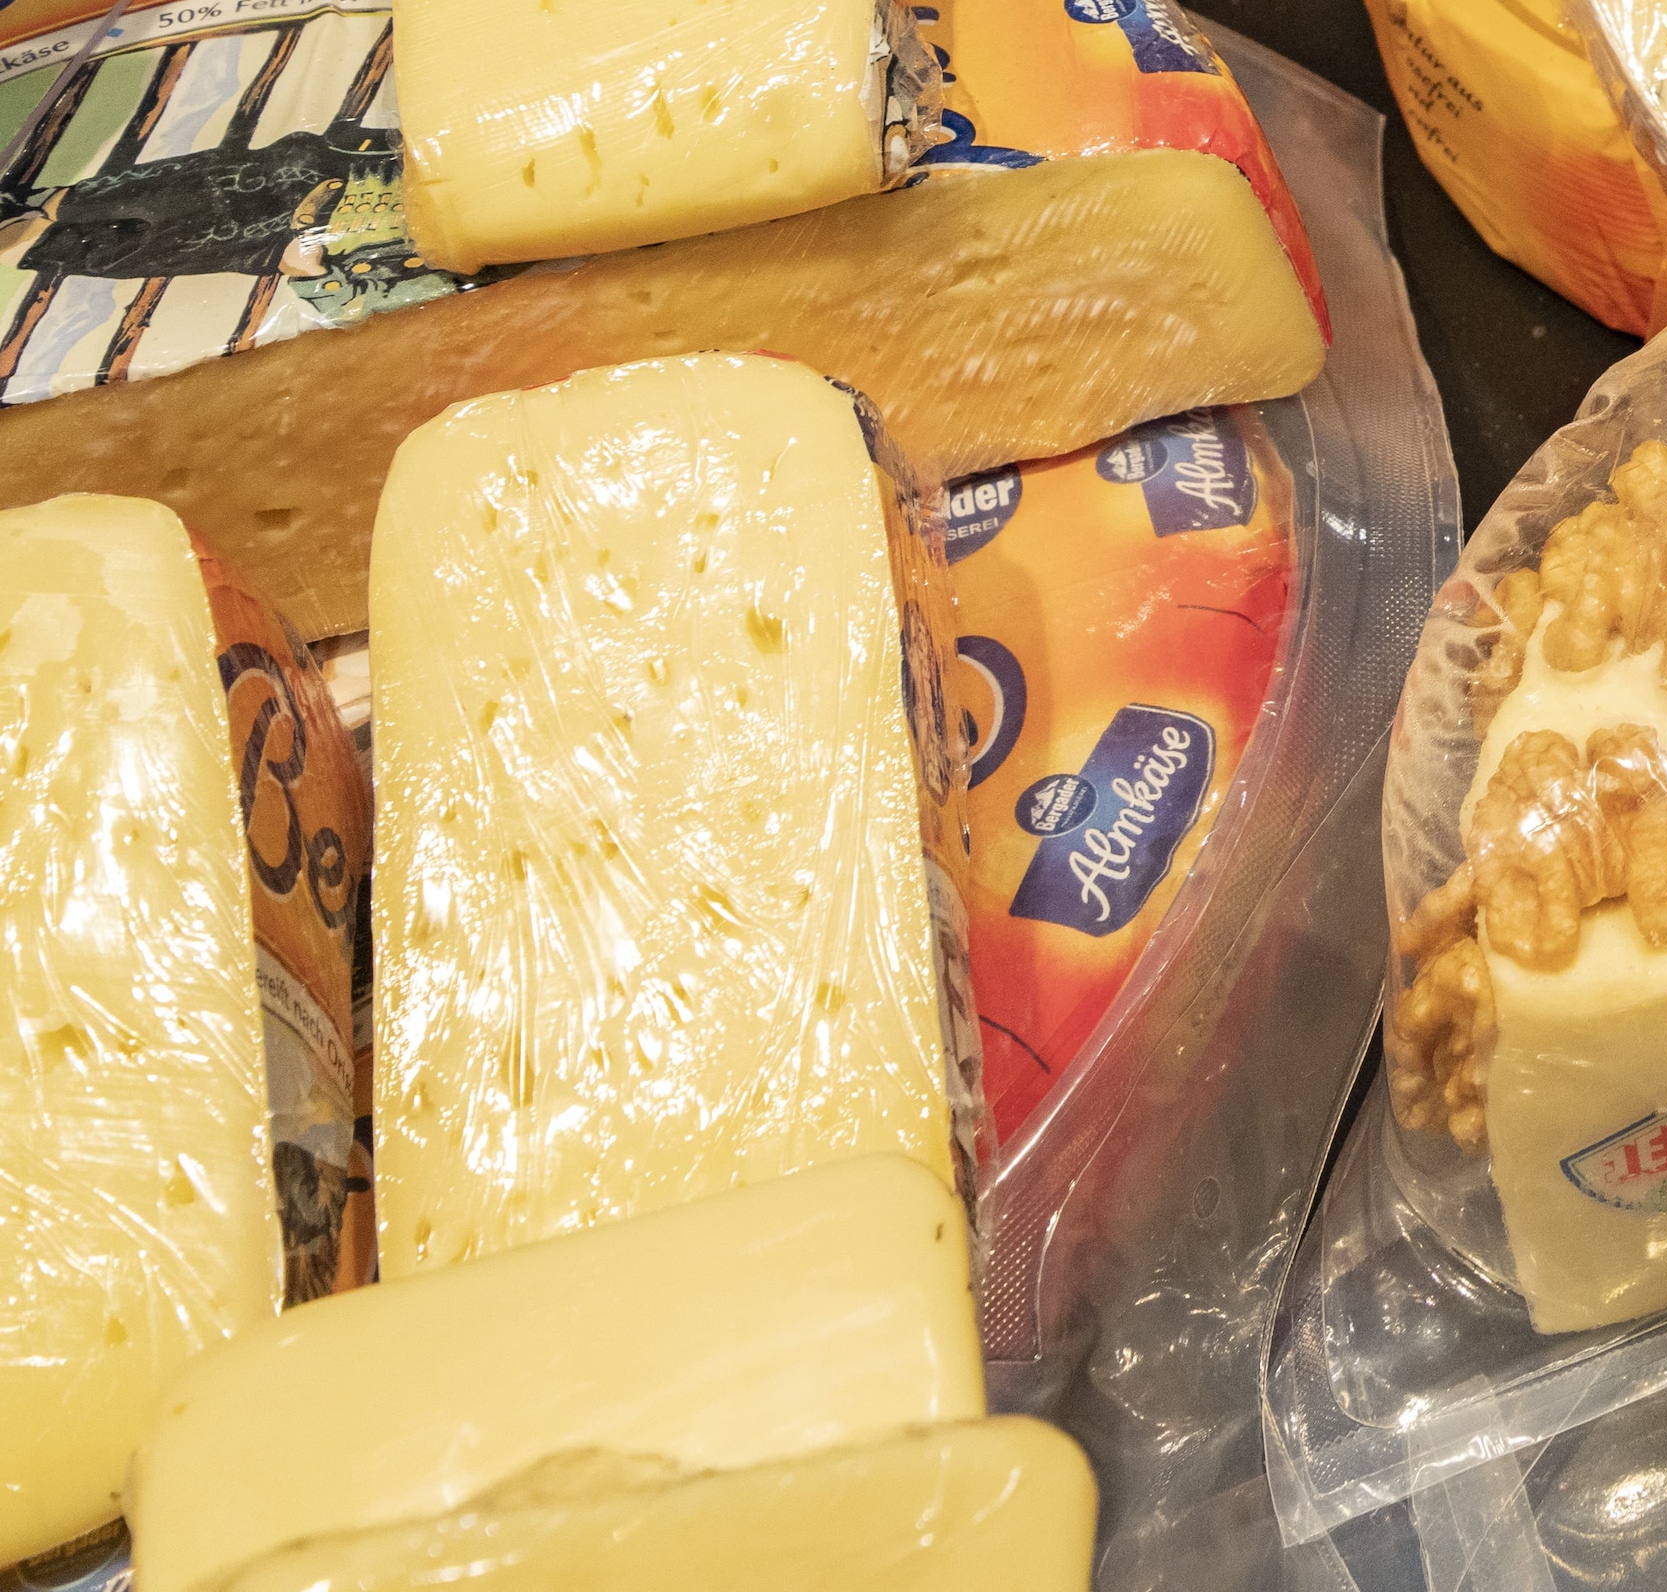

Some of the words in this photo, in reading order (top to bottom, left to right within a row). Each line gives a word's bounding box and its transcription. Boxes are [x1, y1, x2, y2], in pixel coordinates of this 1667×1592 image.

[157, 4, 222, 29] 50%
[1035, 778, 1081, 832] Bergader
[1069, 726, 1192, 922] Almkäse
